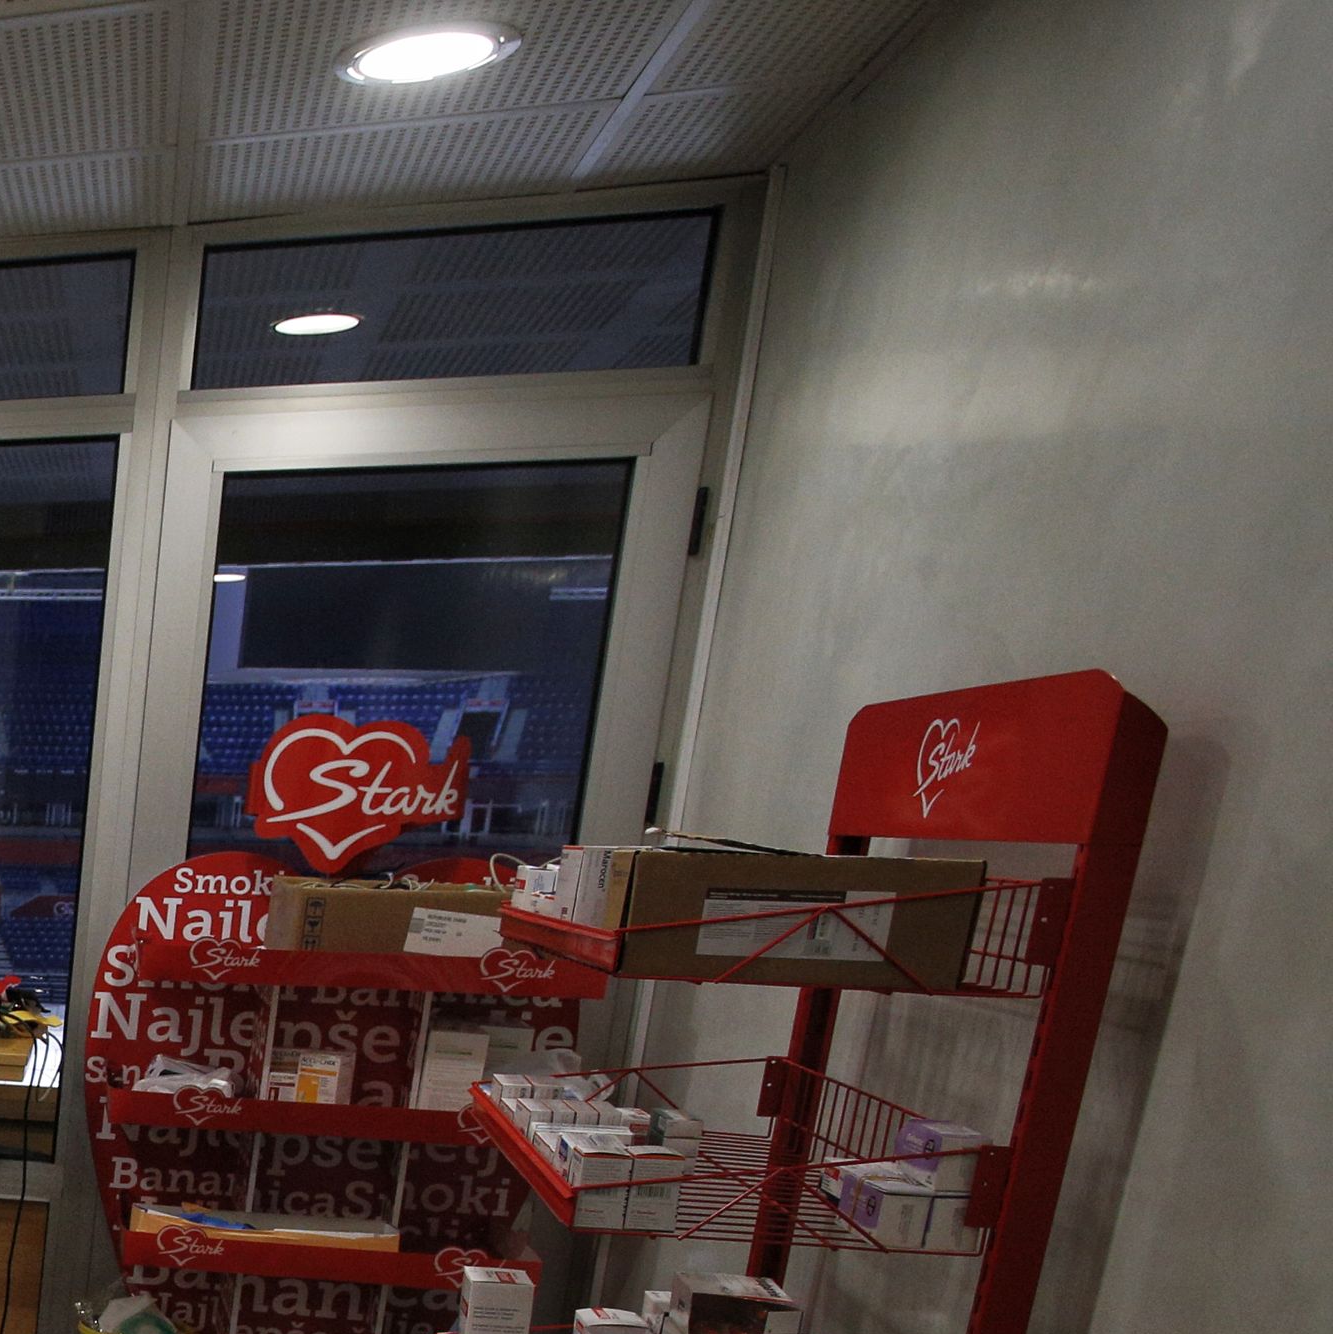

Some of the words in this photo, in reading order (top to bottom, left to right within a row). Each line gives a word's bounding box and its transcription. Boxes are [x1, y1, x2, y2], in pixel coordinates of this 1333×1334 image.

[266, 757, 459, 824] Stark
[191, 947, 261, 969] Stark
[480, 958, 556, 981] Stark
[175, 1096, 243, 1116] Stark
[158, 1235, 226, 1256] Stark
